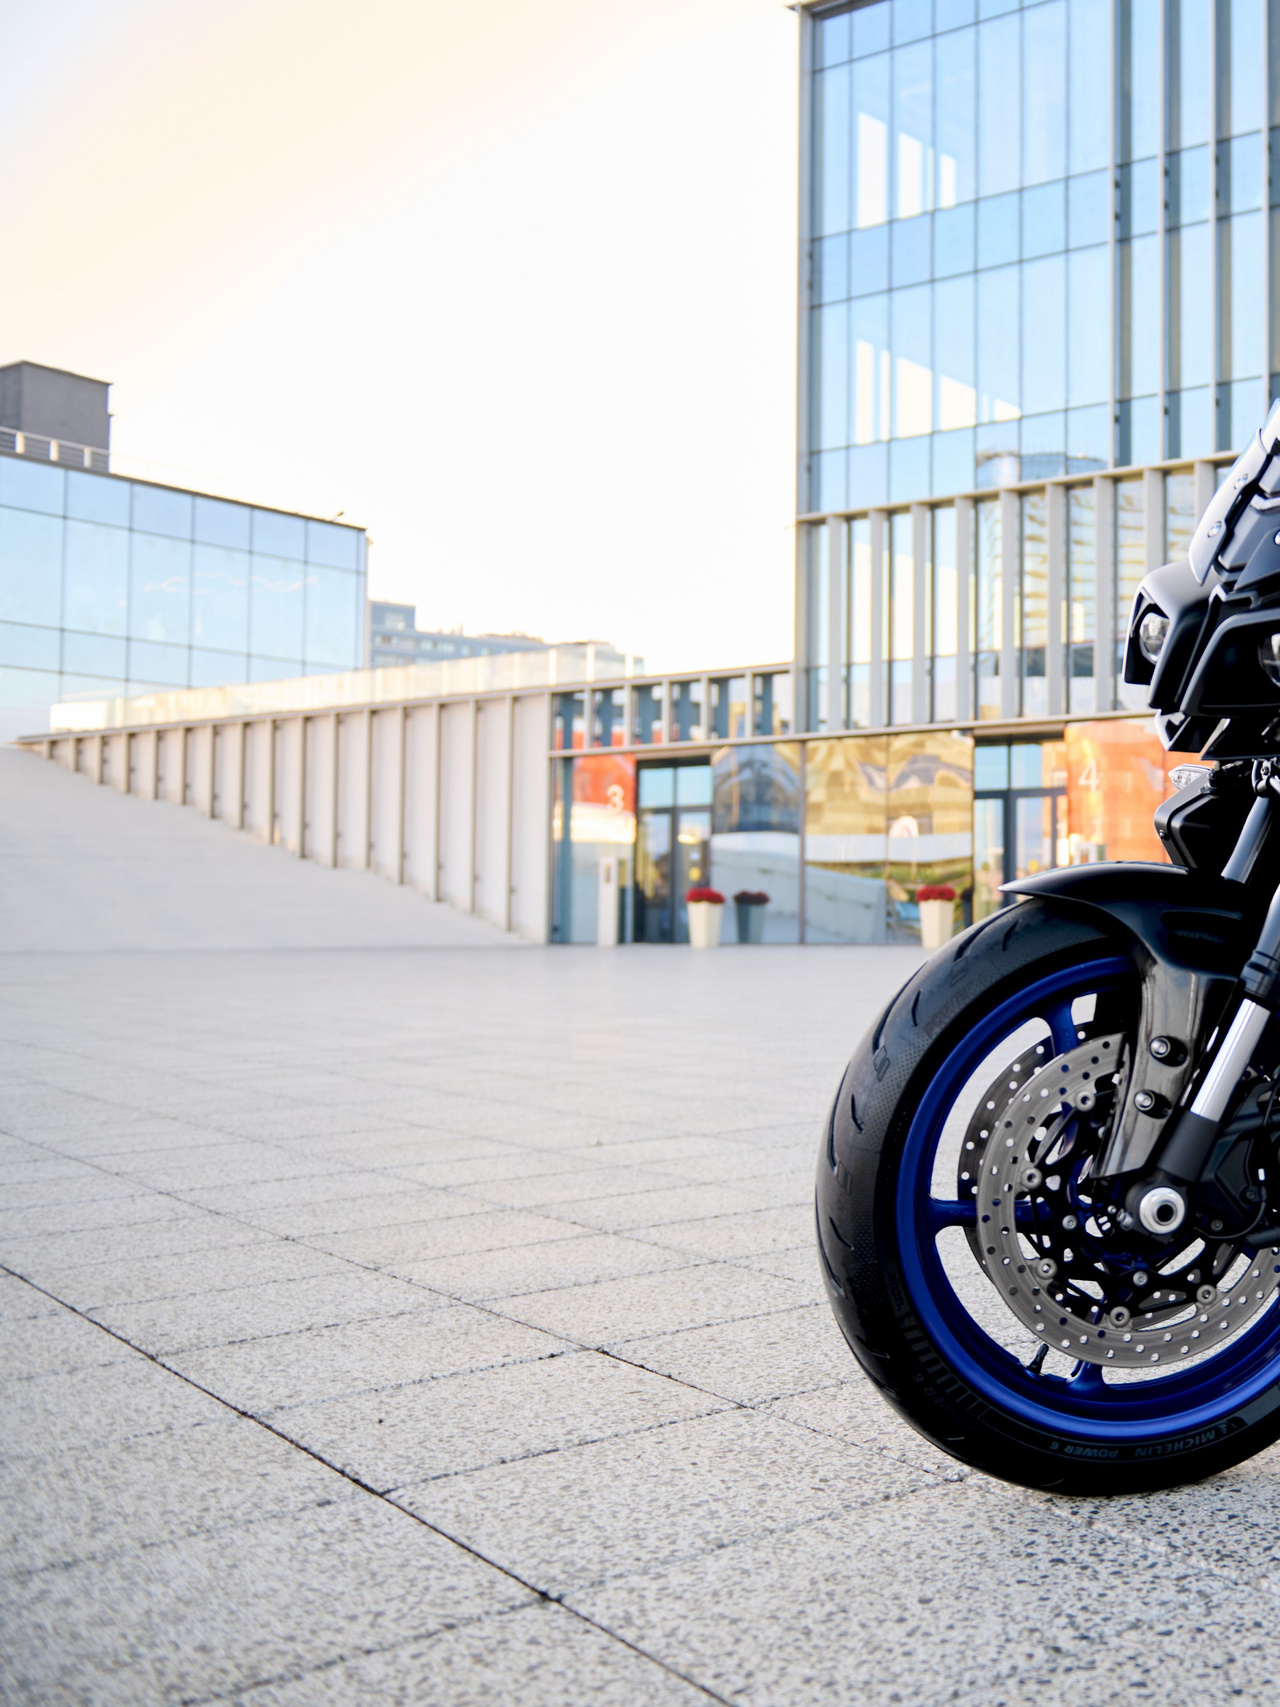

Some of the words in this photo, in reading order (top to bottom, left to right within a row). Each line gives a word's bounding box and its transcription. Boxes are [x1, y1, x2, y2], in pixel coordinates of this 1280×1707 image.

[1078, 758, 1100, 791] 4
[607, 784, 624, 815] 3
[1049, 1440, 1060, 1451] 6
[1063, 1445, 1119, 1459] POWER
[1134, 1429, 1216, 1457] MICHELIN
